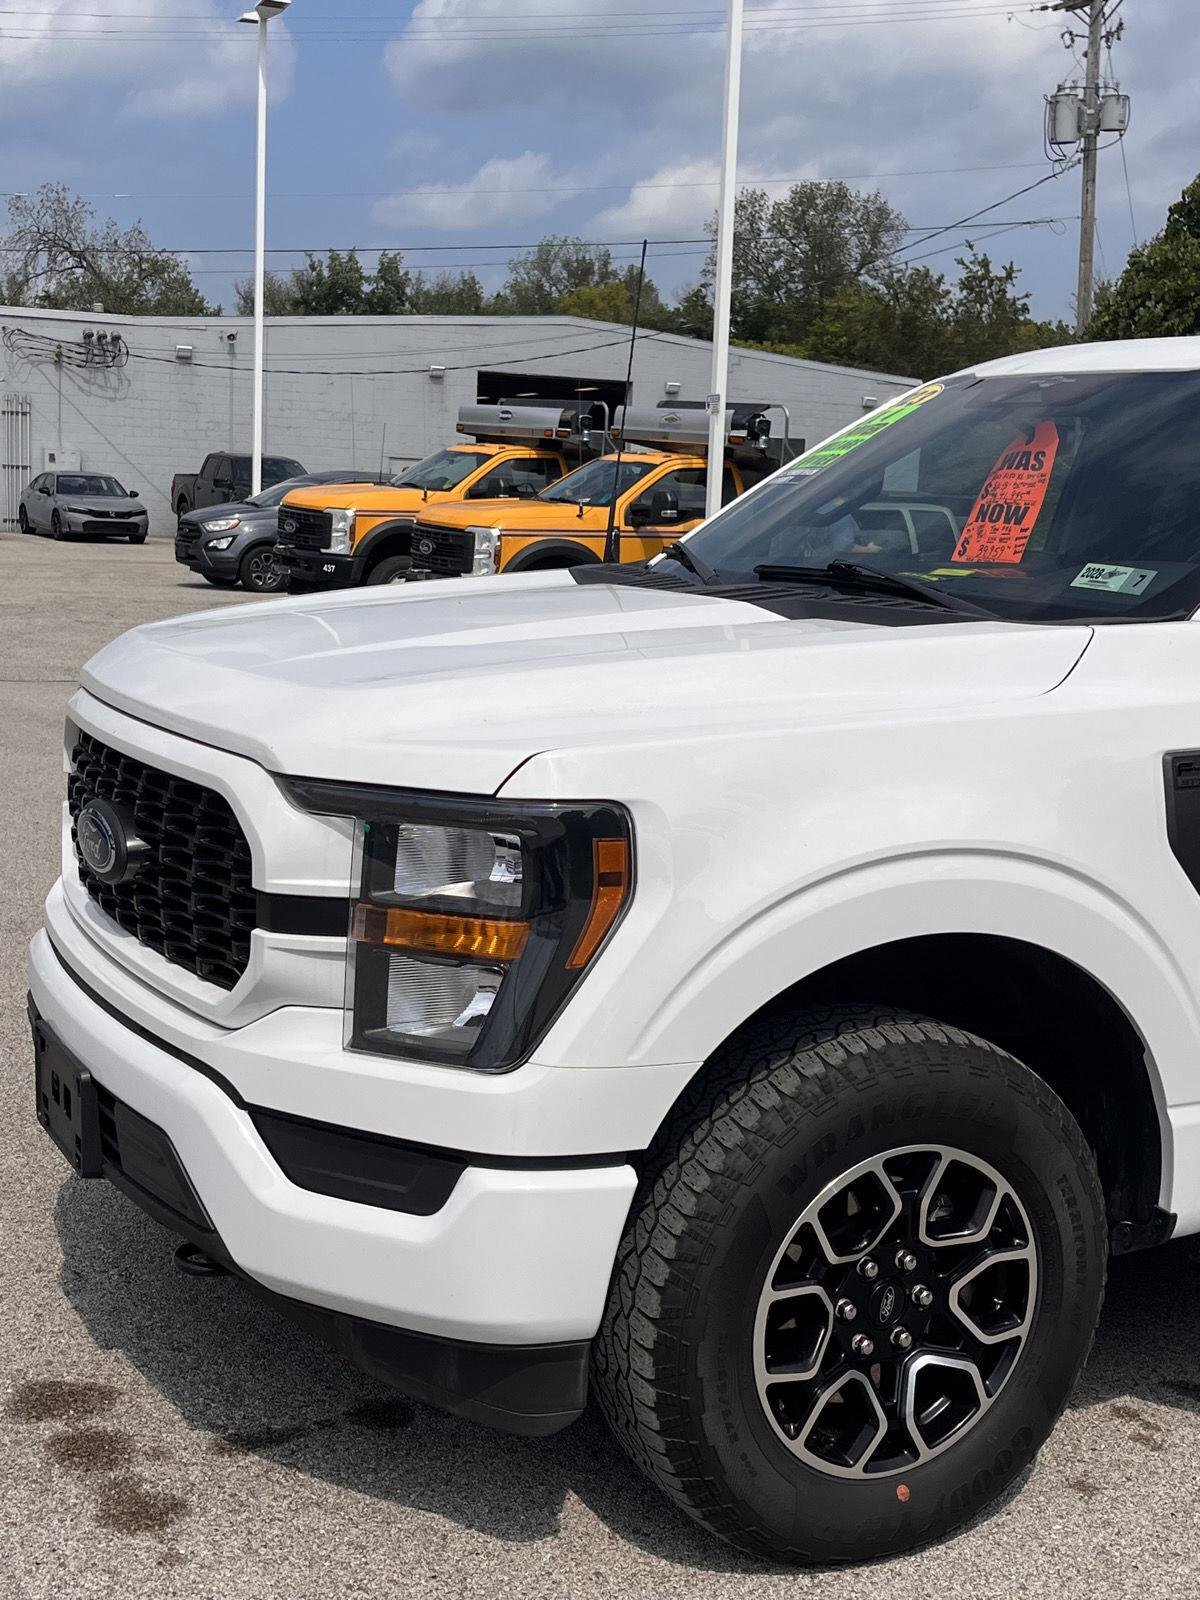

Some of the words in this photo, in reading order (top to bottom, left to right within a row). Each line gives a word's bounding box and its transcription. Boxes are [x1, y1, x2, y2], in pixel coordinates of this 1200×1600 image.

[1001, 451, 1046, 471] WAS
[975, 503, 1029, 525] NOW
[958, 537, 969, 557] $
[323, 564, 336, 573] 437
[1132, 574, 1147, 588] 7
